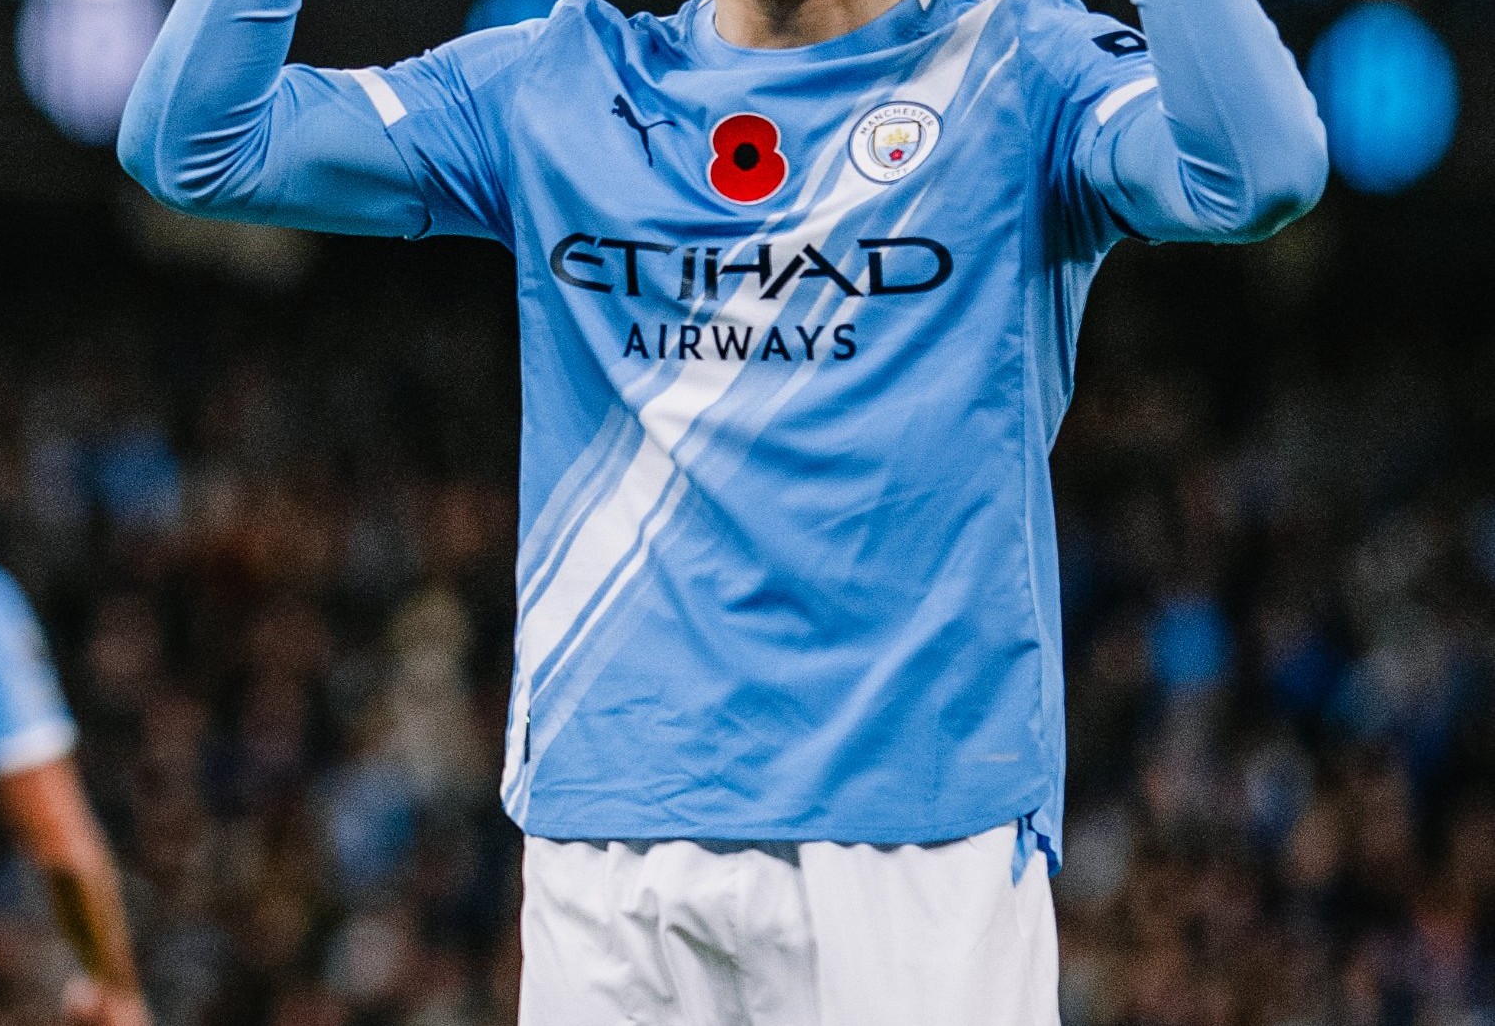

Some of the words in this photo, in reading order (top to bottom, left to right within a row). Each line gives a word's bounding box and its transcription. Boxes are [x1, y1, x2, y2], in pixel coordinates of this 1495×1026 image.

[859, 107, 935, 135] MANCHESTER
[883, 166, 909, 180] CITY
[549, 232, 954, 301] ETIHAD
[623, 323, 857, 361] AIRWAYS
